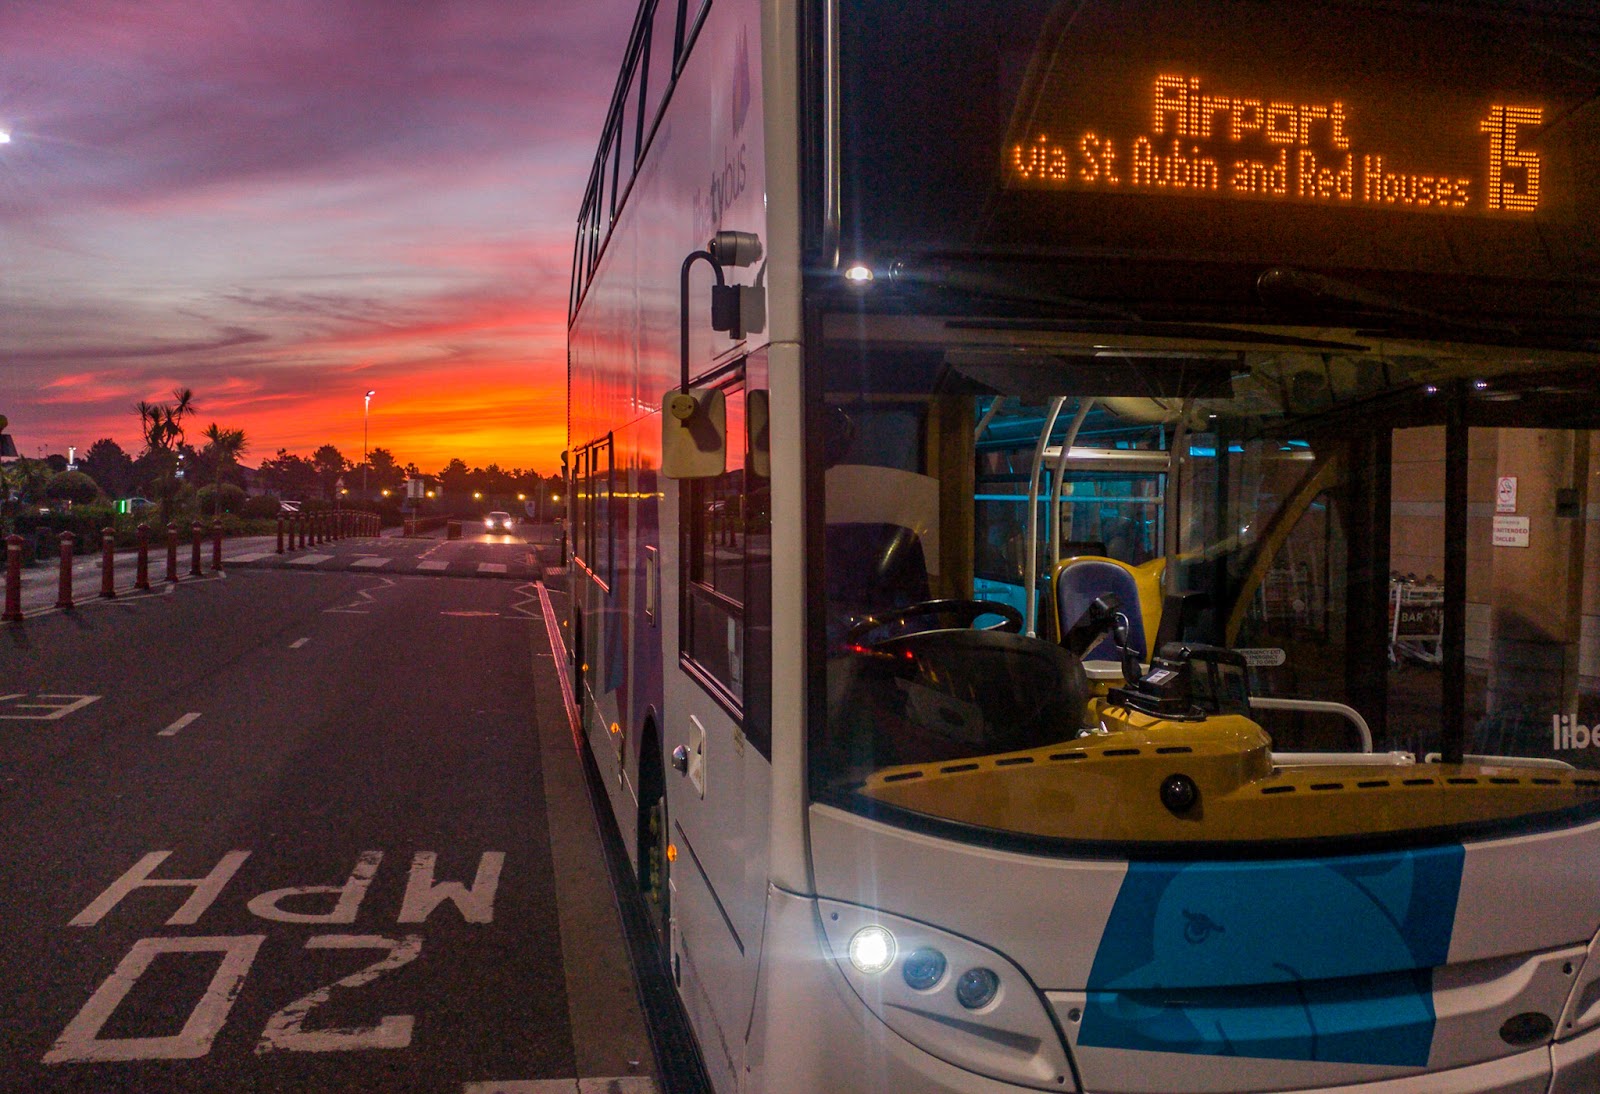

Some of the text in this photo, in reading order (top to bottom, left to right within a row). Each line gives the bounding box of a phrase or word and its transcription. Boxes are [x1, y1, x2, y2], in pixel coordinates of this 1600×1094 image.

[1155, 74, 1349, 149] Airport
[1014, 131, 1471, 208] via St Aubin and Red Houses
[1480, 104, 1543, 212] 15
[67, 850, 506, 926] MPH
[41, 934, 426, 1064] 20
